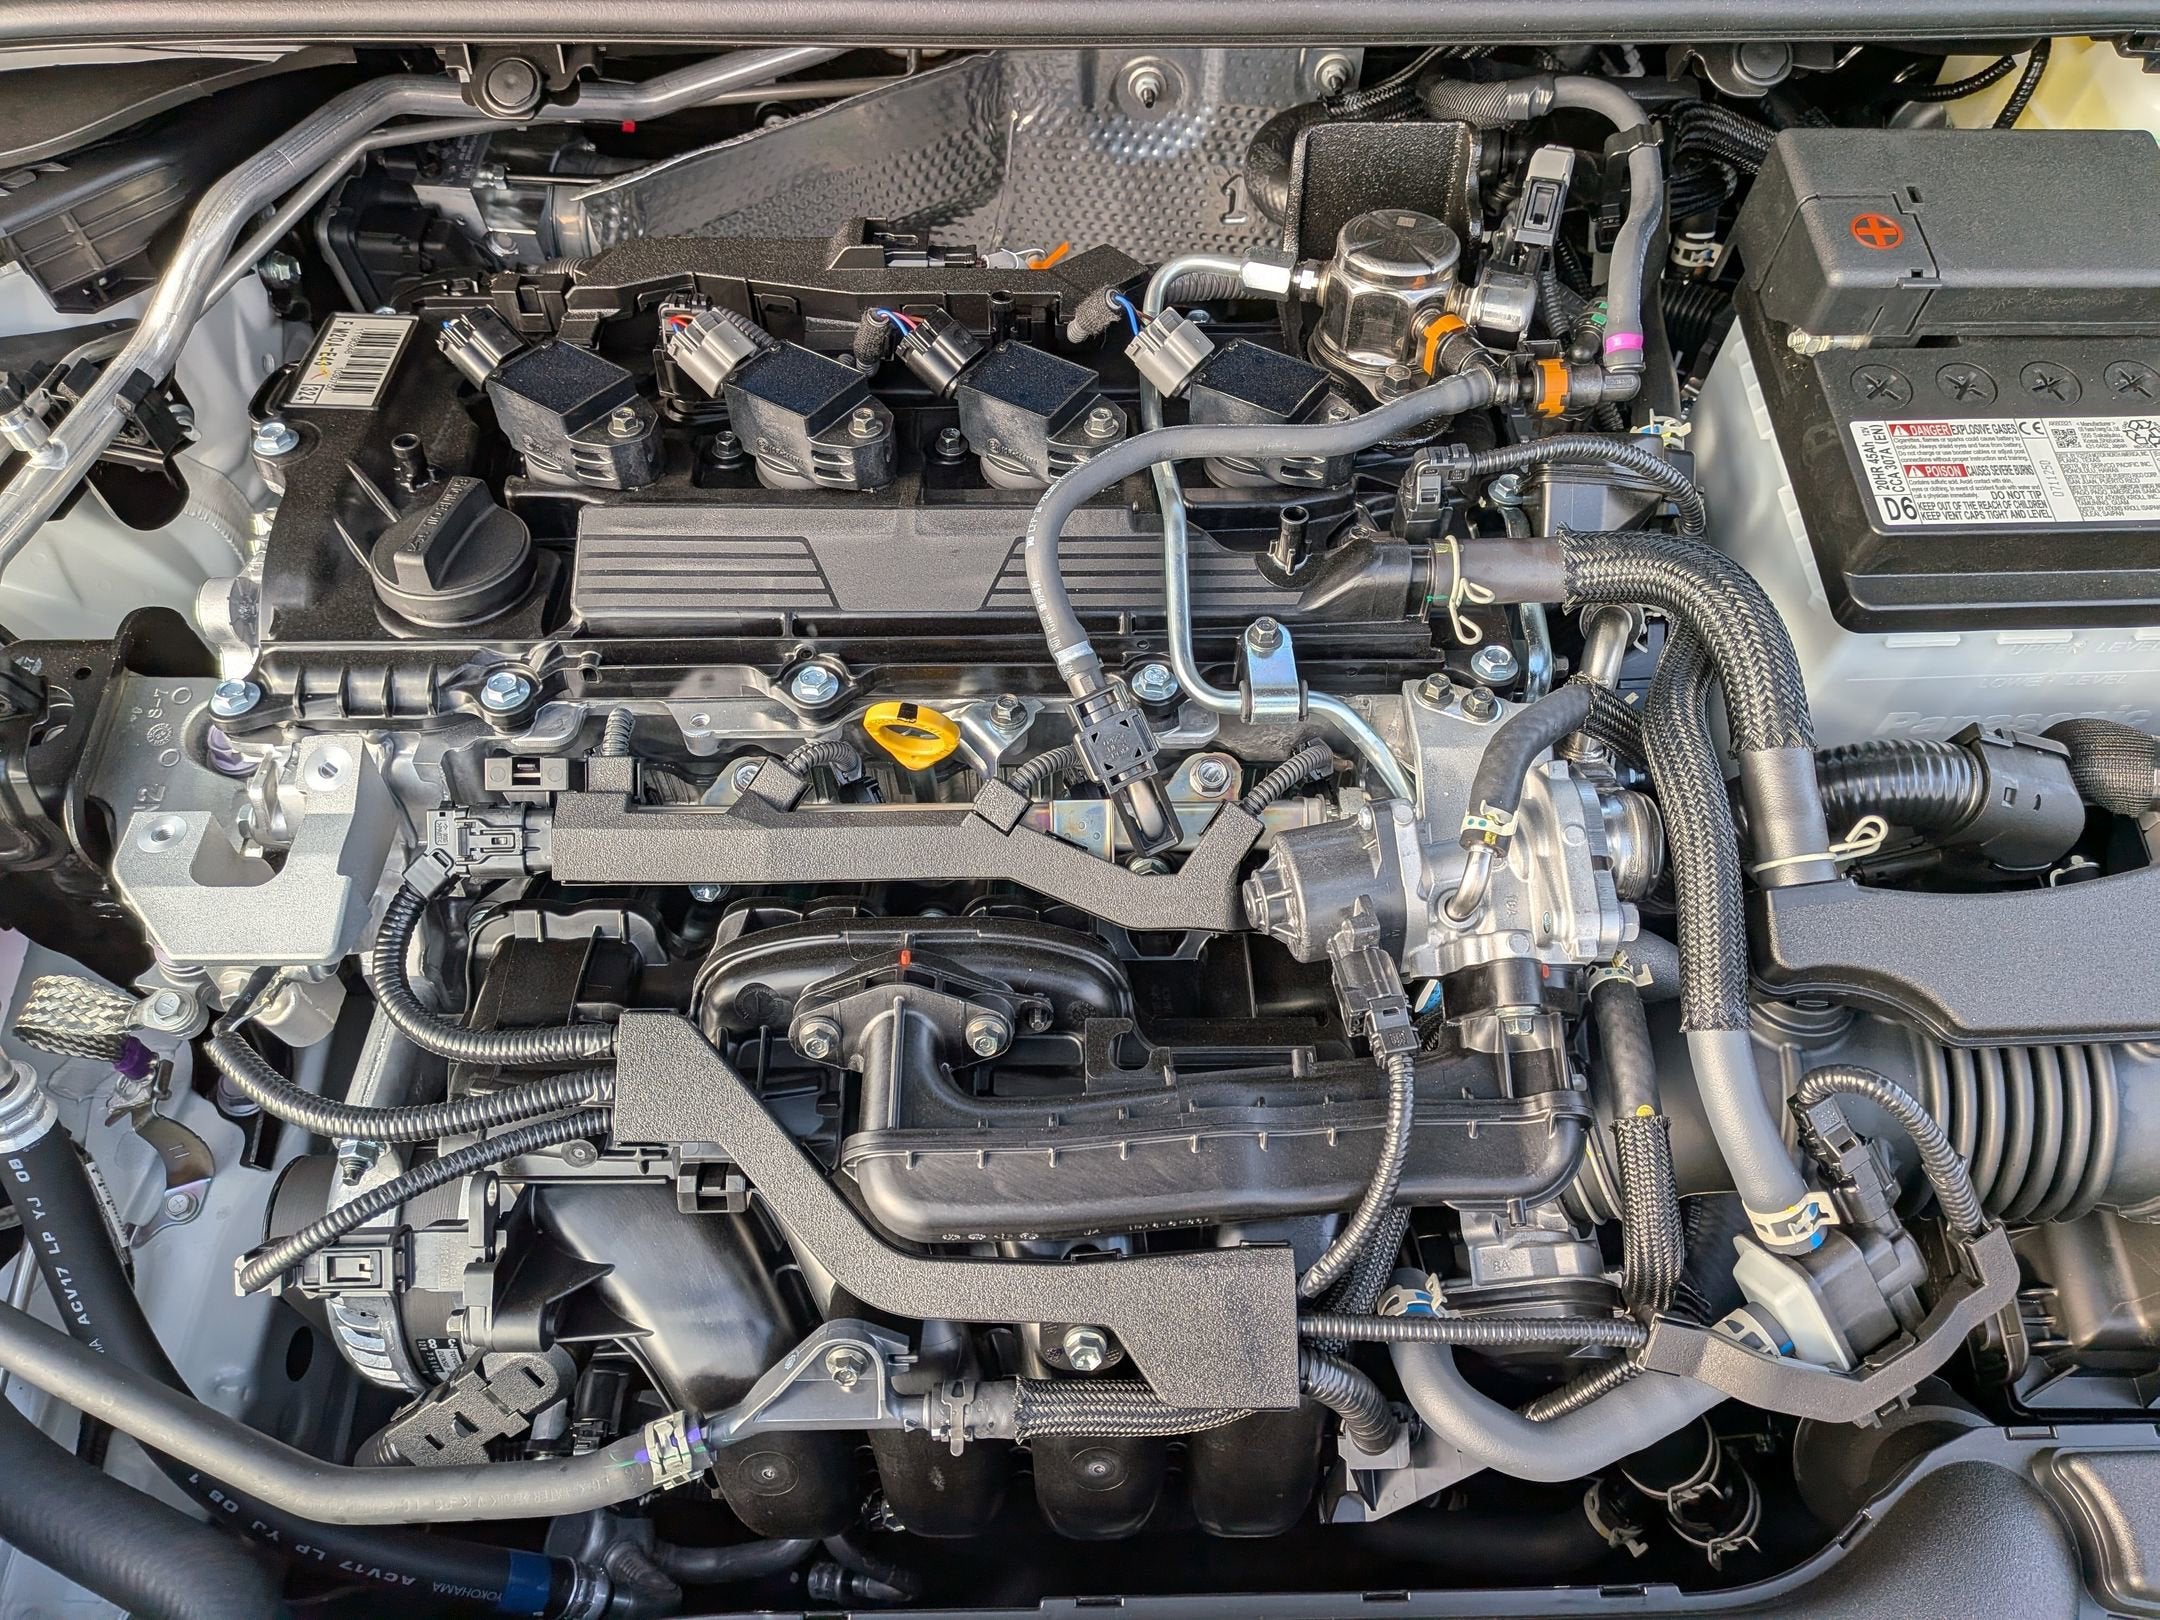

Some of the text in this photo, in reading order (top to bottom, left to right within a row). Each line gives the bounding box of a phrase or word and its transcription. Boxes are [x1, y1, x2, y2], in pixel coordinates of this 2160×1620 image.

[1908, 425, 1950, 435] DANGER
[1949, 423, 2018, 434] EXPLOSIVE GASES
[1861, 441, 1890, 491] 20HR 45Ah
[1869, 424, 1905, 492] CCA 307A (EN)
[1924, 465, 1962, 476] POISON
[1965, 464, 2034, 475] CAUSES SEVERE BURNS
[1917, 502, 1937, 510] KEEP
[1951, 501, 1963, 509] OF
[1963, 501, 1978, 509] THE
[1977, 501, 2002, 509] REACH
[2001, 500, 2012, 508] OF
[2011, 499, 2048, 508] CHILDREN
[1990, 490, 2042, 499] DO NOT TIP
[1883, 496, 1917, 520] D6
[1920, 509, 2051, 520] KEEP VENT CAPS TIGHT AND LEVEL
[26, 1197, 46, 1219] YJ
[41, 1231, 61, 1254] LP
[55, 1266, 91, 1325] ACV17
[252, 1520, 282, 1543] YJ
[295, 1543, 326, 1561] LP
[339, 1560, 417, 1586] ACV17
[432, 1581, 503, 1602] YOKOHAMA
